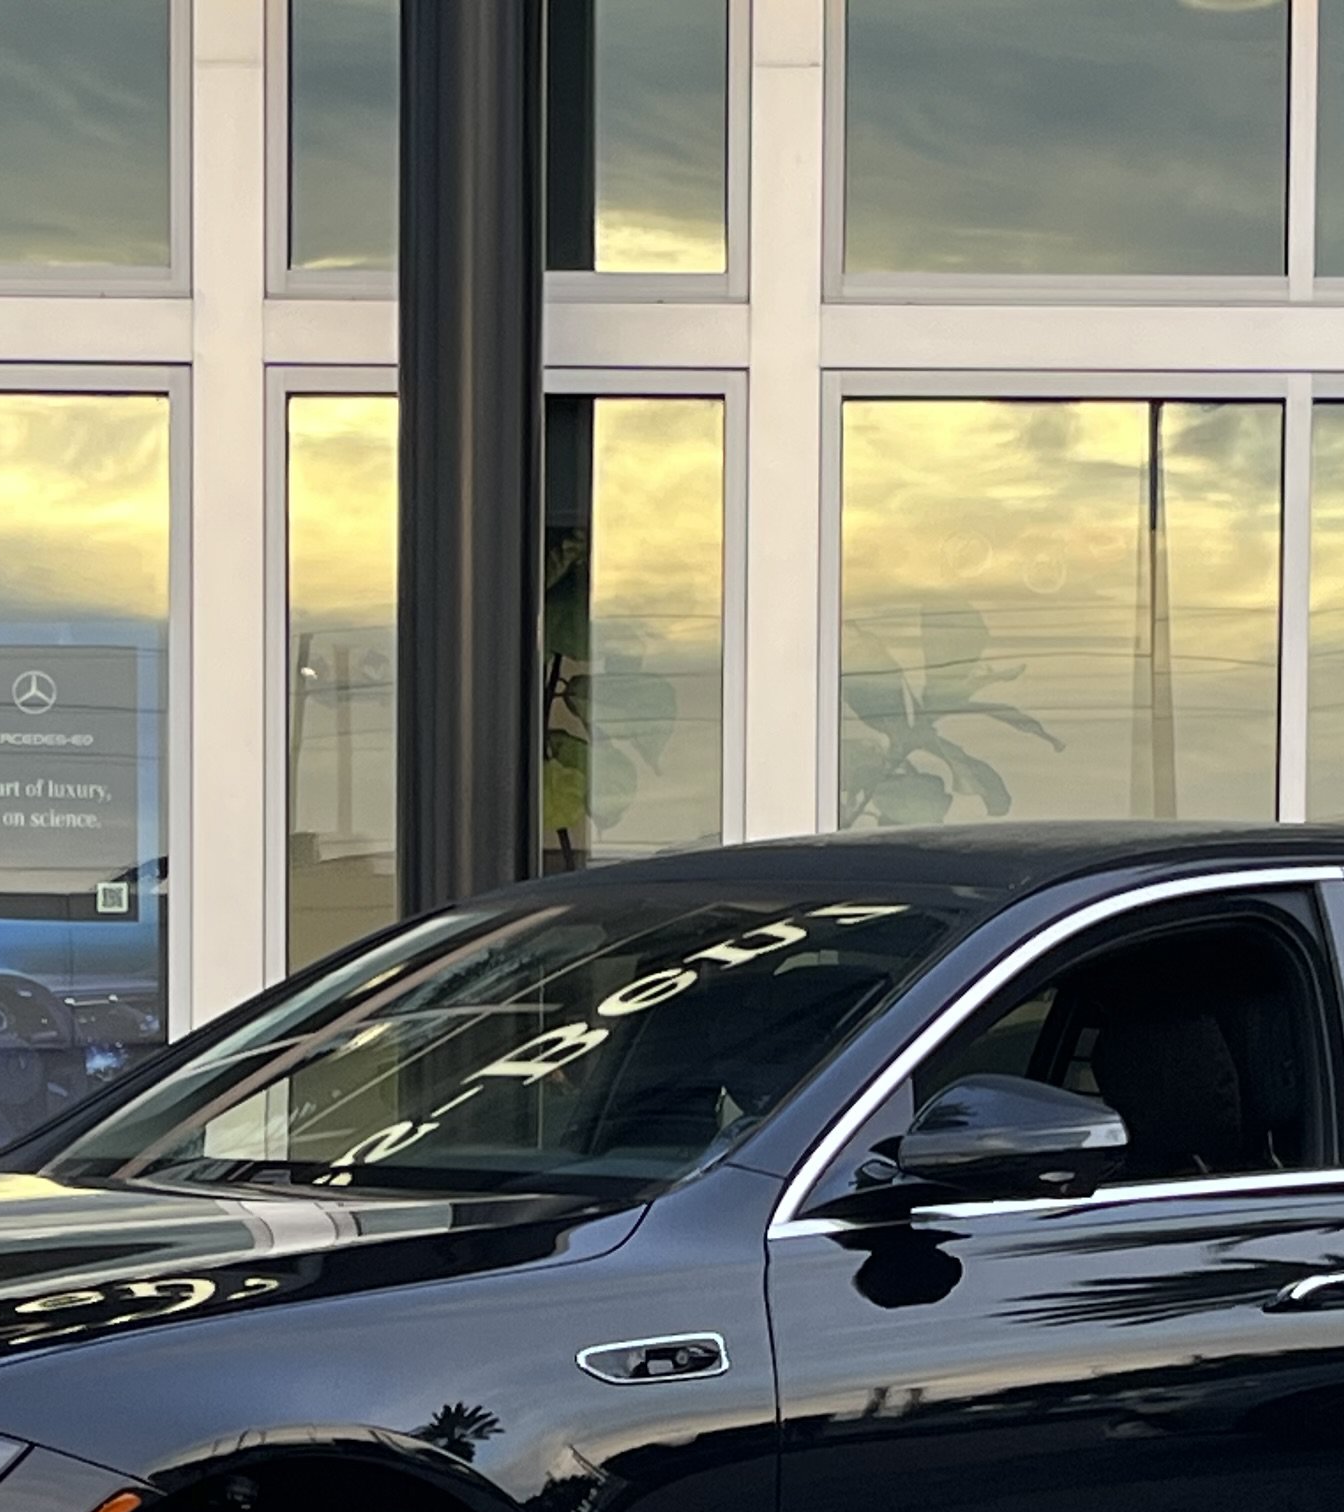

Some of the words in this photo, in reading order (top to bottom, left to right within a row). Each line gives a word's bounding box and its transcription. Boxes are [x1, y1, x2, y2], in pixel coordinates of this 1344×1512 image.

[25, 778, 45, 798] of
[48, 779, 112, 803] luxury,
[2, 811, 25, 827] on
[30, 808, 102, 829] science.
